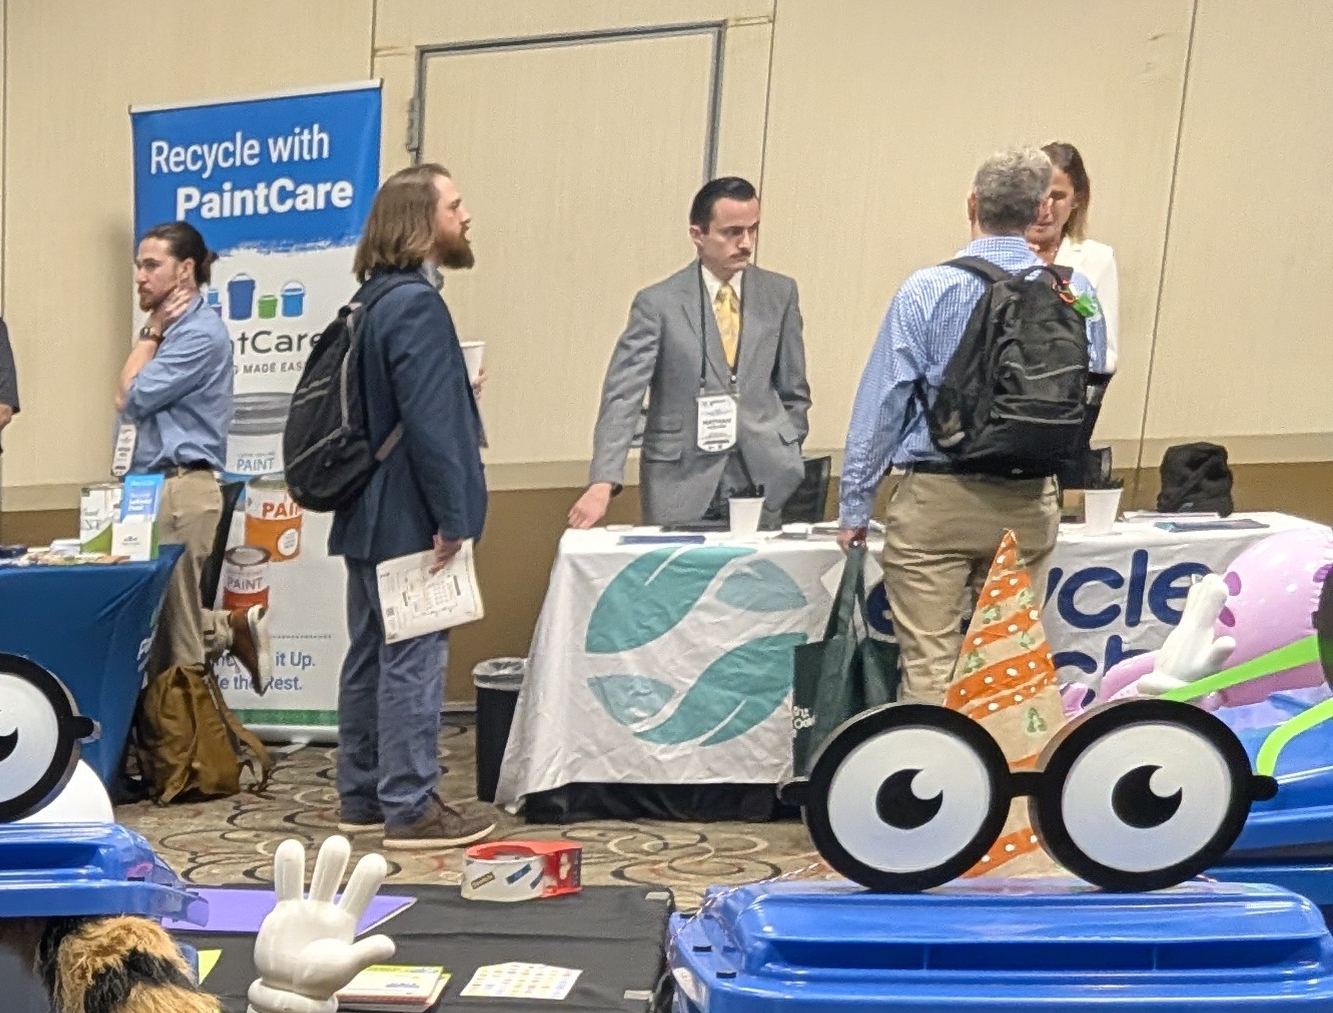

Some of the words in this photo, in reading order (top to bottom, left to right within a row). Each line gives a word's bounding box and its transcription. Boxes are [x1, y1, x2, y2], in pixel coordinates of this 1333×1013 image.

[149, 131, 260, 180] Recycle
[267, 123, 330, 163] with
[175, 178, 354, 222] PaintCare
[243, 361, 277, 375] MADE
[280, 360, 307, 373] EAS
[236, 456, 276, 472] PAINT
[226, 576, 263, 591] PAINT
[275, 651, 286, 667] it
[290, 650, 316, 671] Up.
